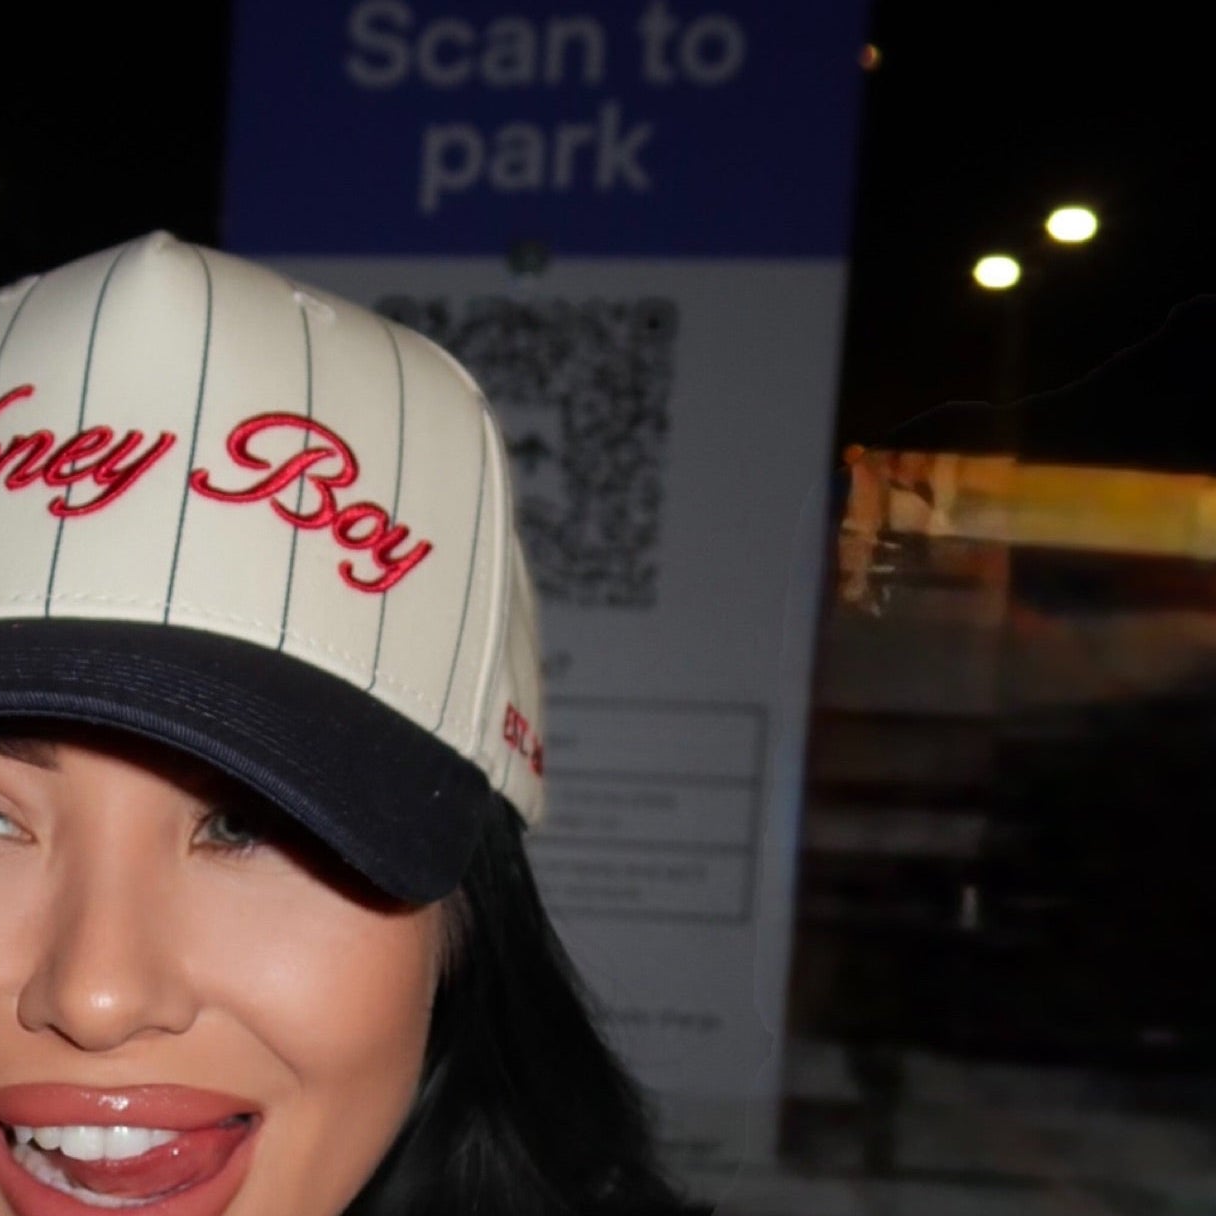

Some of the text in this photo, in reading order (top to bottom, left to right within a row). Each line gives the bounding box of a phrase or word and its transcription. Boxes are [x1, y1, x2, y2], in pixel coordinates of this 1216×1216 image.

[345, 0, 748, 89] Scan to
[418, 101, 655, 214] park
[190, 411, 433, 593] Boy
